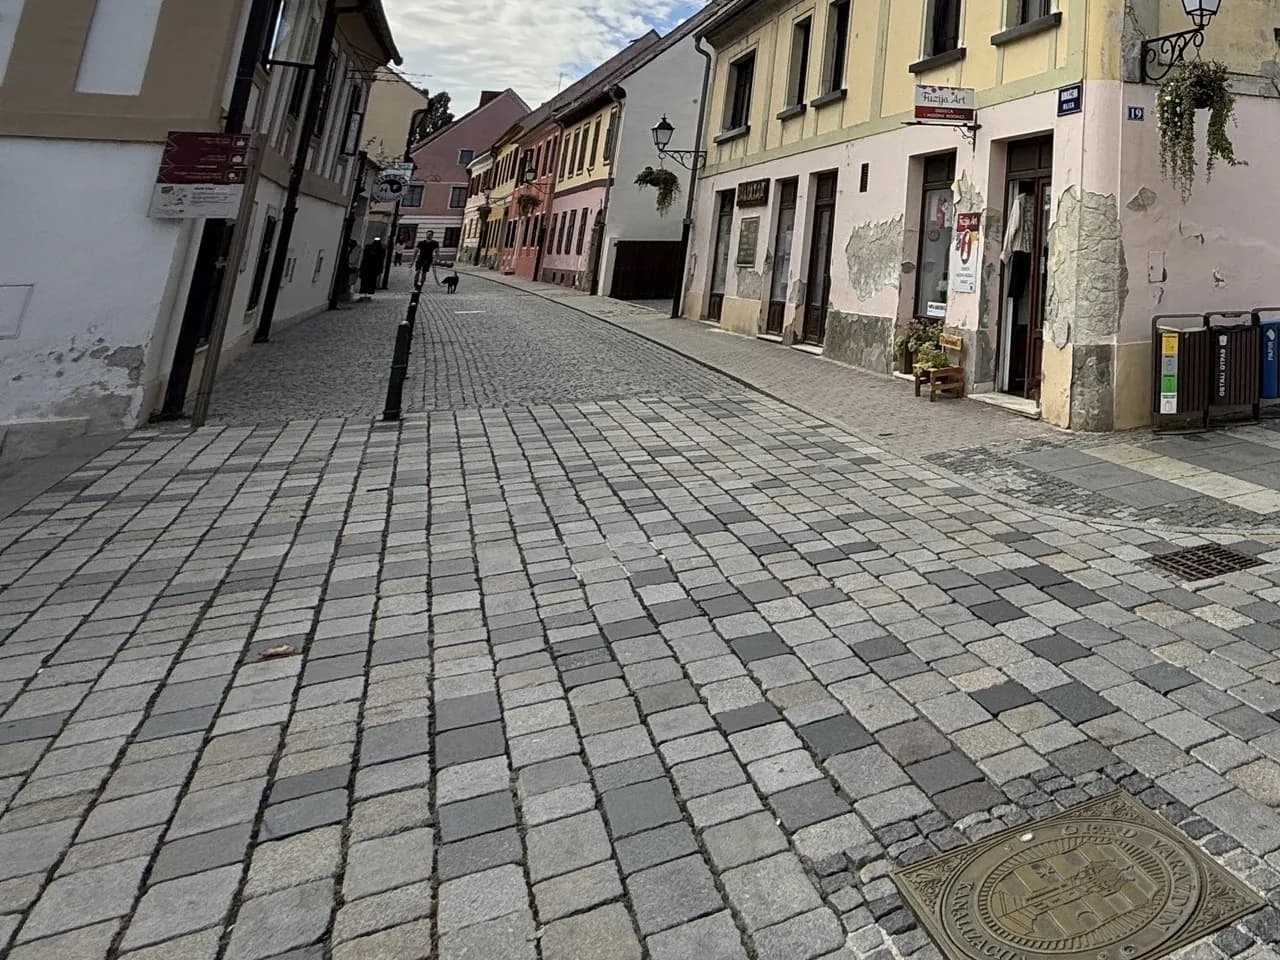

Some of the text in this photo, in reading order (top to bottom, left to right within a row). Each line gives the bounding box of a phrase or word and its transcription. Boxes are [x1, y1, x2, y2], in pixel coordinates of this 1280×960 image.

[922, 91, 966, 106] Fuzija Art
[1130, 108, 1142, 119] 19
[1063, 824, 1138, 839] GRAD
